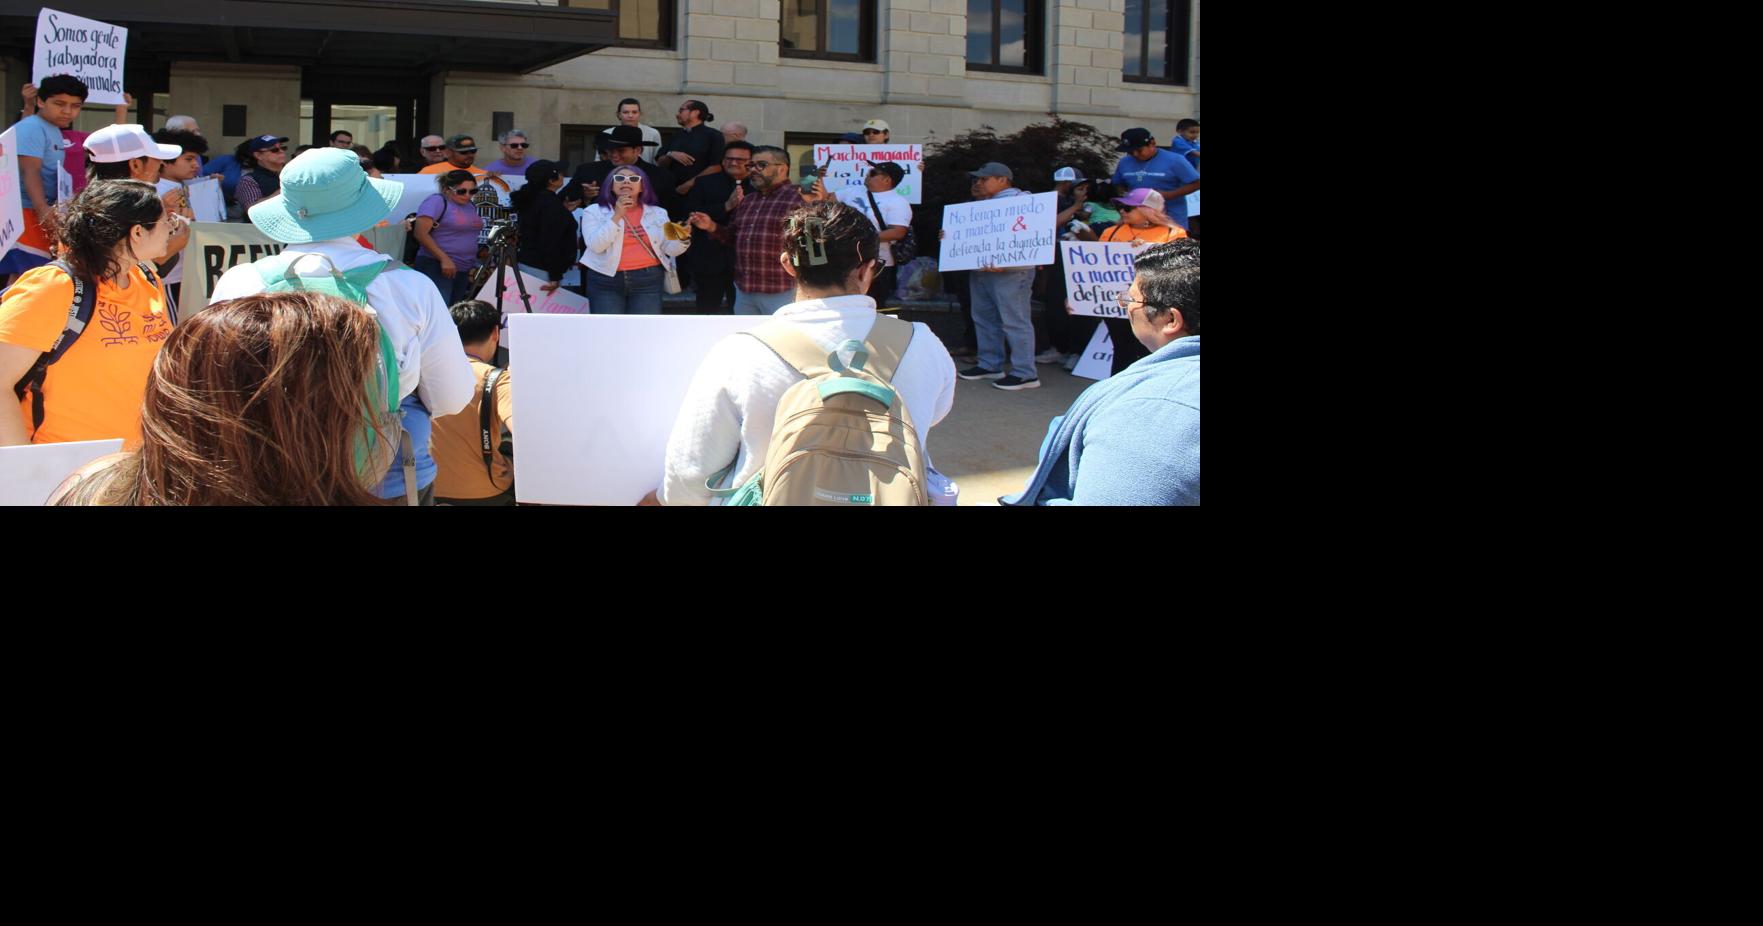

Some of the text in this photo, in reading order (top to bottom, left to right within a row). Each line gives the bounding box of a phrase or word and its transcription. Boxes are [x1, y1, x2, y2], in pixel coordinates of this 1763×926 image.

[44, 14, 119, 51] Somos gente
[47, 45, 117, 72] trabajadora
[818, 145, 921, 162] Marcha migrante
[950, 197, 1044, 225] No tenga miedo
[953, 215, 1027, 241] a marchar &
[949, 229, 1053, 258] defienda la dignidad
[1069, 245, 1097, 265] No
[1072, 271, 1085, 283] a
[1073, 283, 1131, 304] defie
